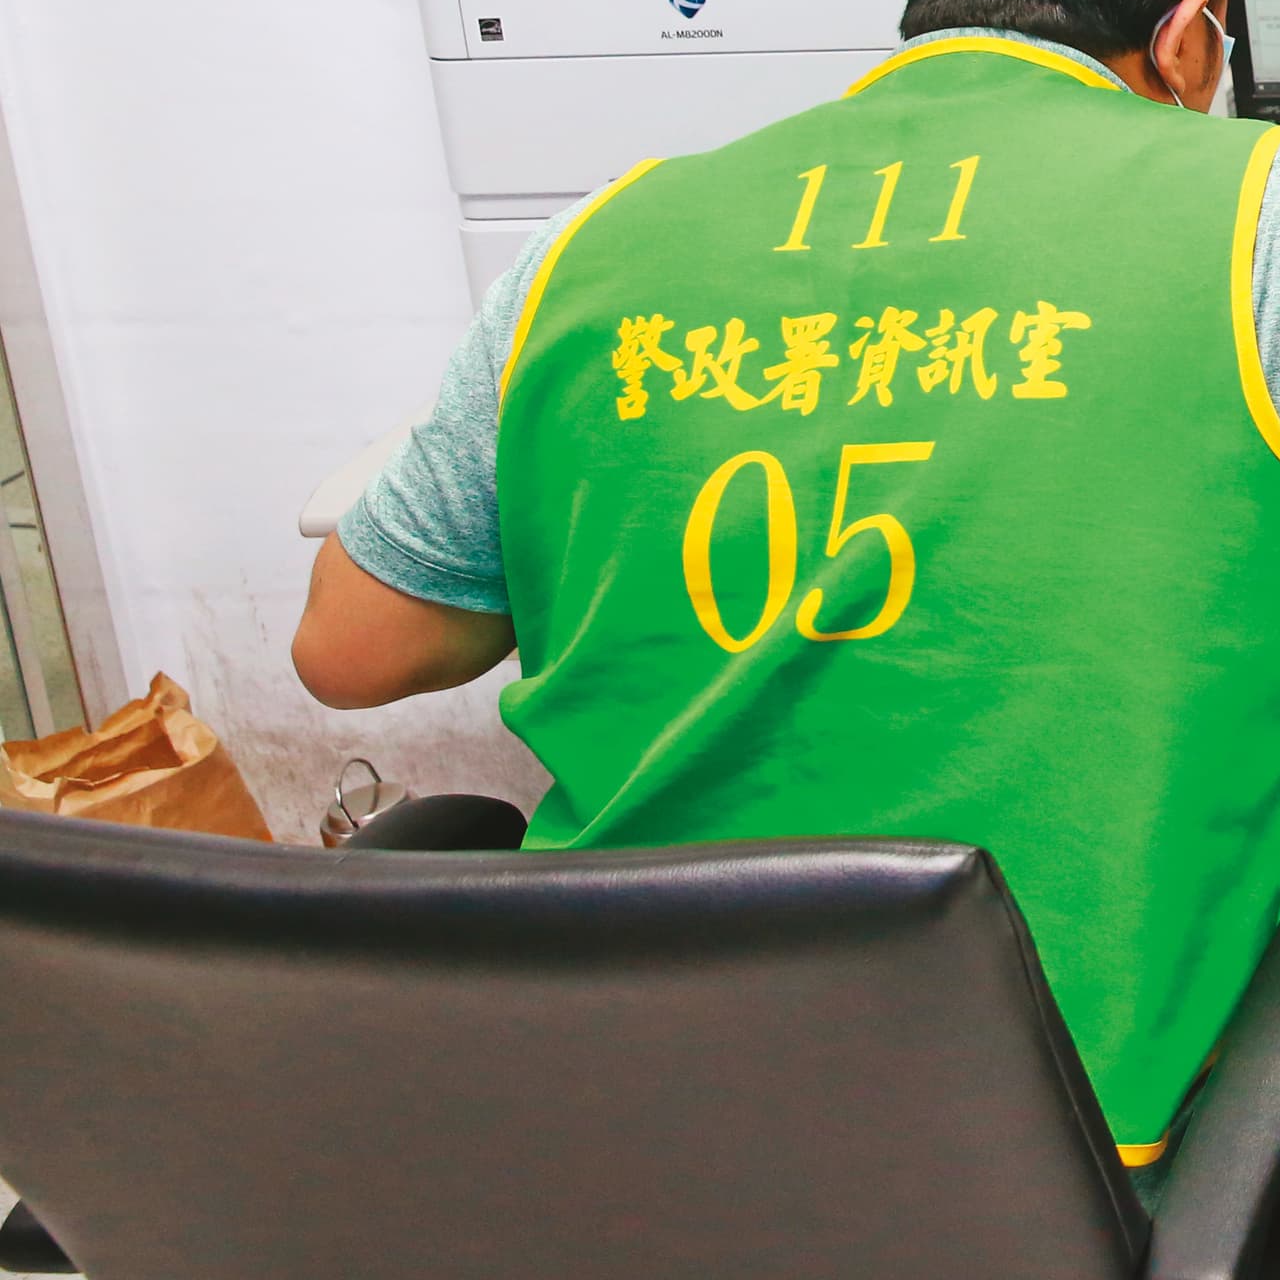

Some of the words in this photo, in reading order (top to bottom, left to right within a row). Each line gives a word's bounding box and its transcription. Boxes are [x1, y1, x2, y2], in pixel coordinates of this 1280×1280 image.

[611, 300, 1092, 421] 警政署資訊室
[682, 441, 935, 653] 05
